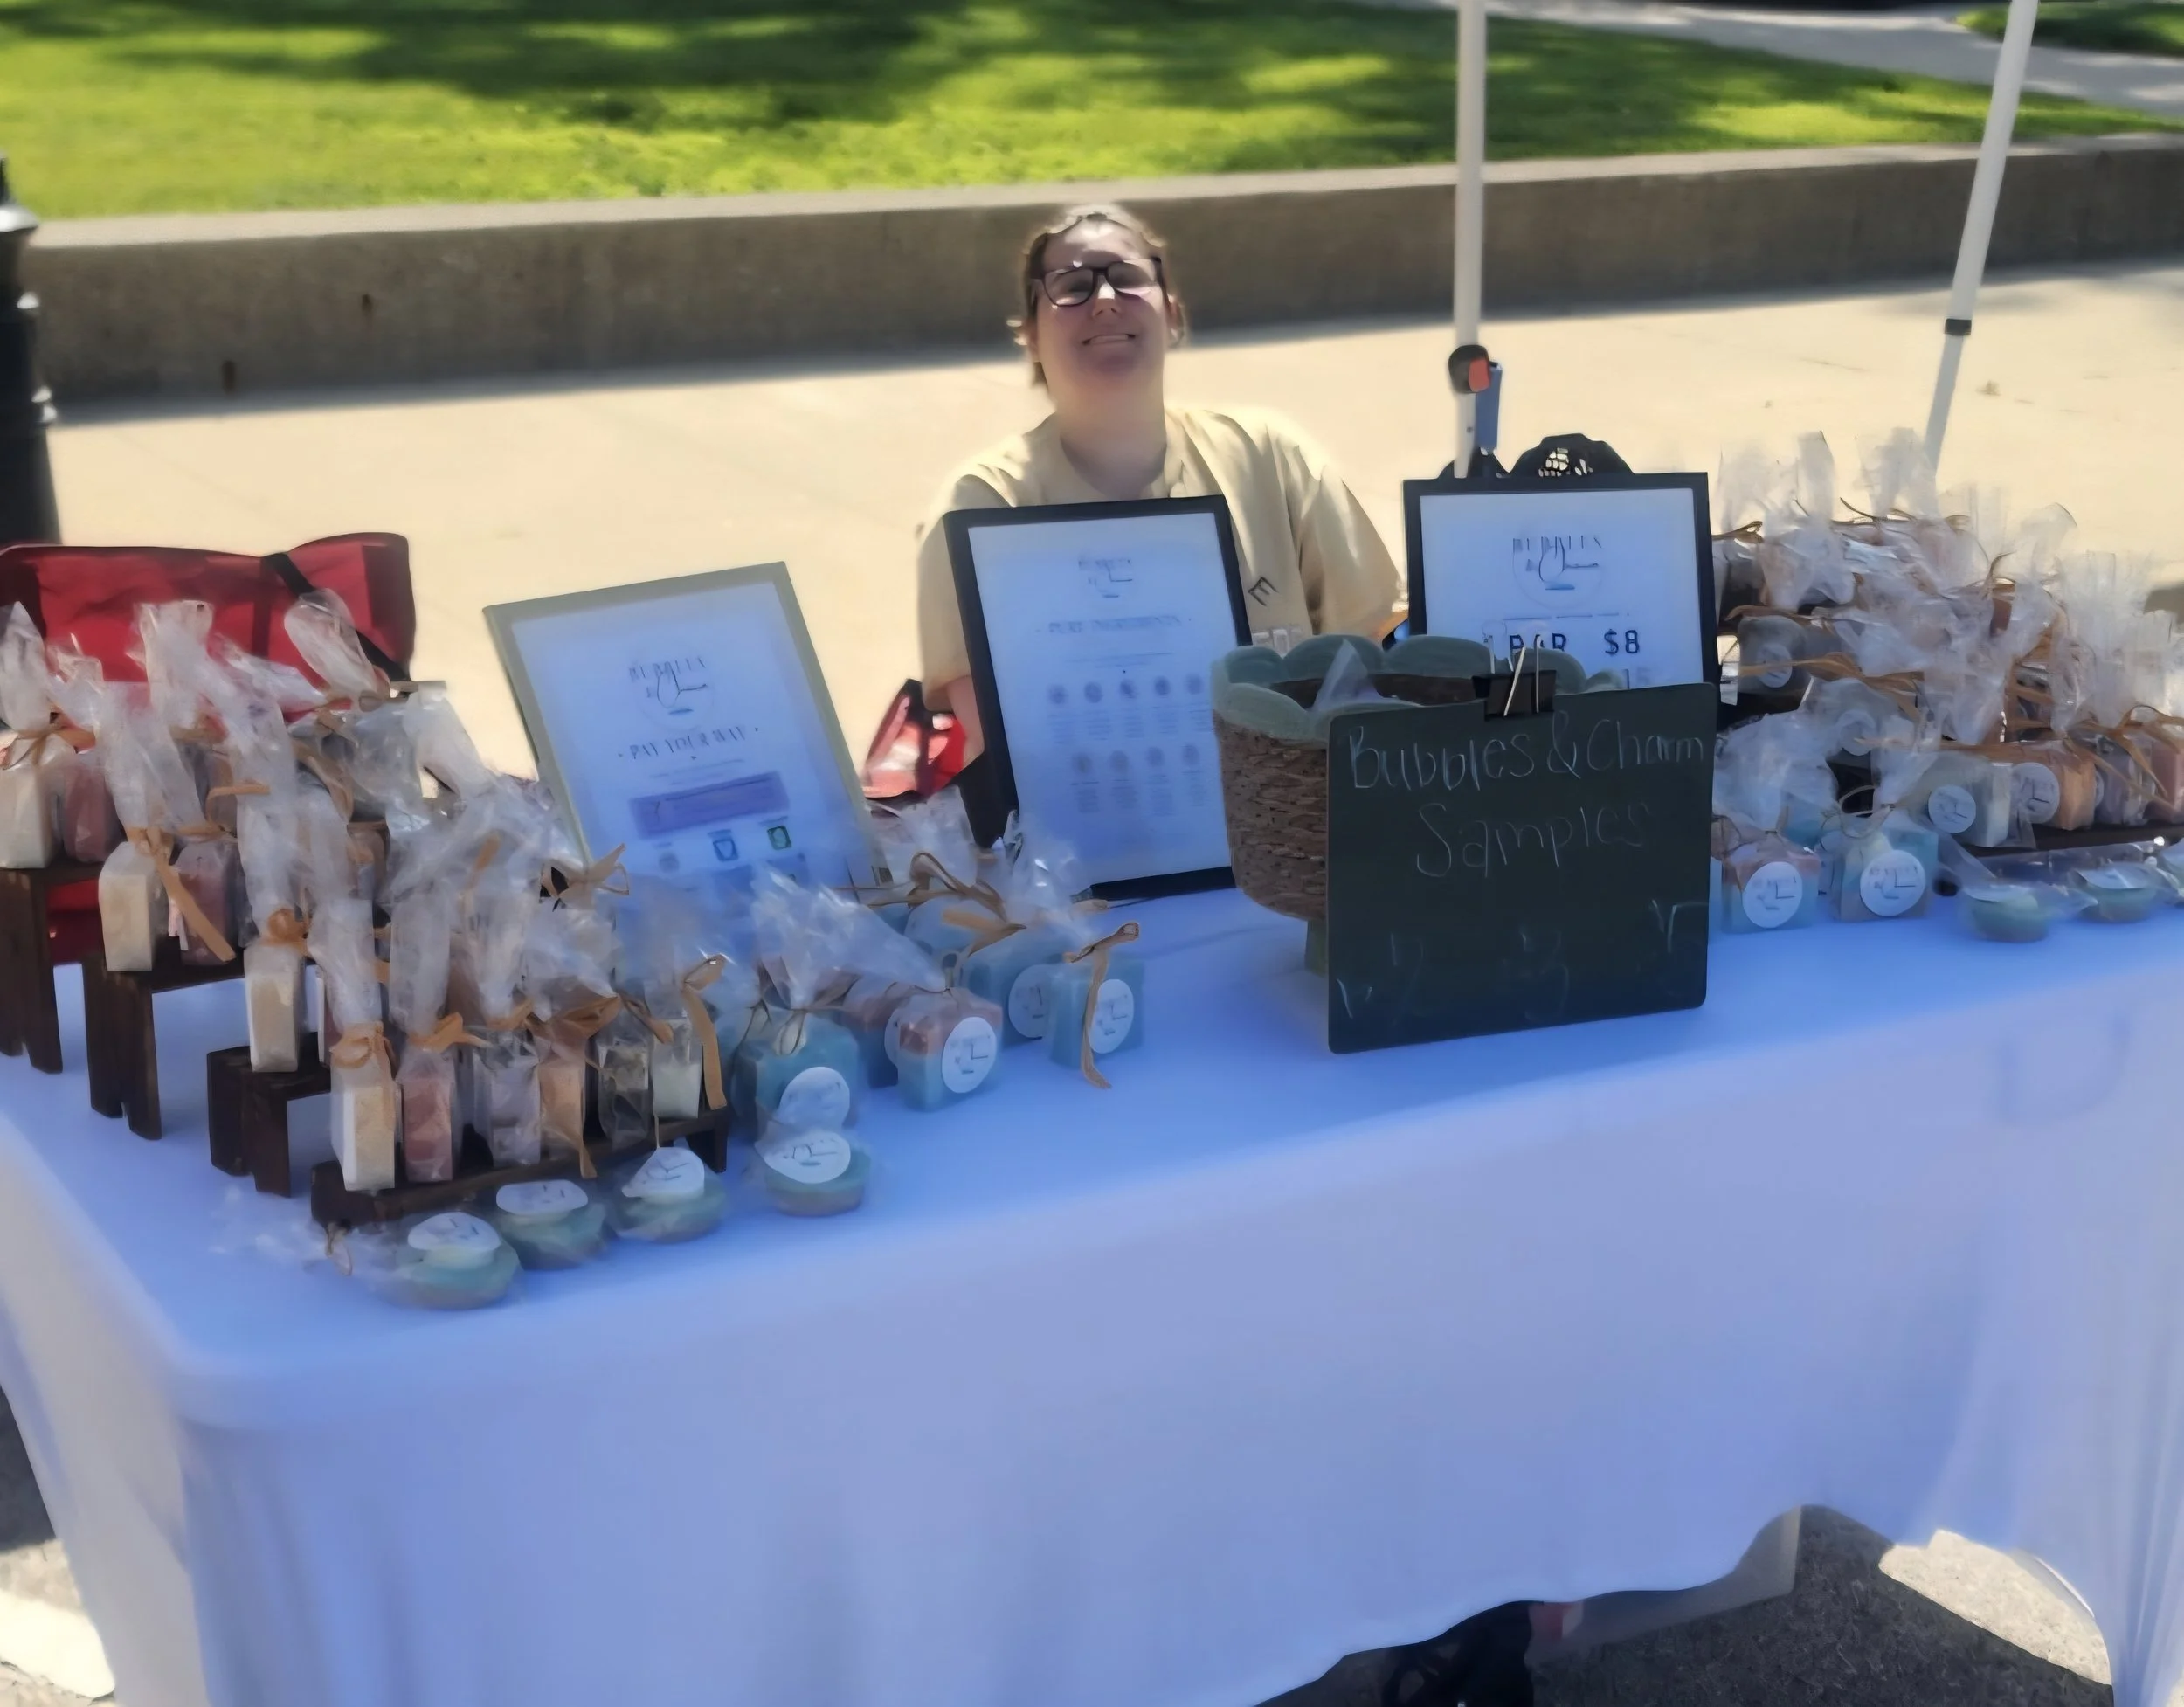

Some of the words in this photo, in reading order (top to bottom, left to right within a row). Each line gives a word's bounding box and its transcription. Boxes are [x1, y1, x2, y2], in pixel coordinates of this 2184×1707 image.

[1603, 627, 1641, 656] $8
[1348, 724, 1536, 791] Bubbles
[1546, 709, 1582, 780] &
[1586, 717, 1704, 772] Charm
[1415, 802, 1650, 879] Samples
